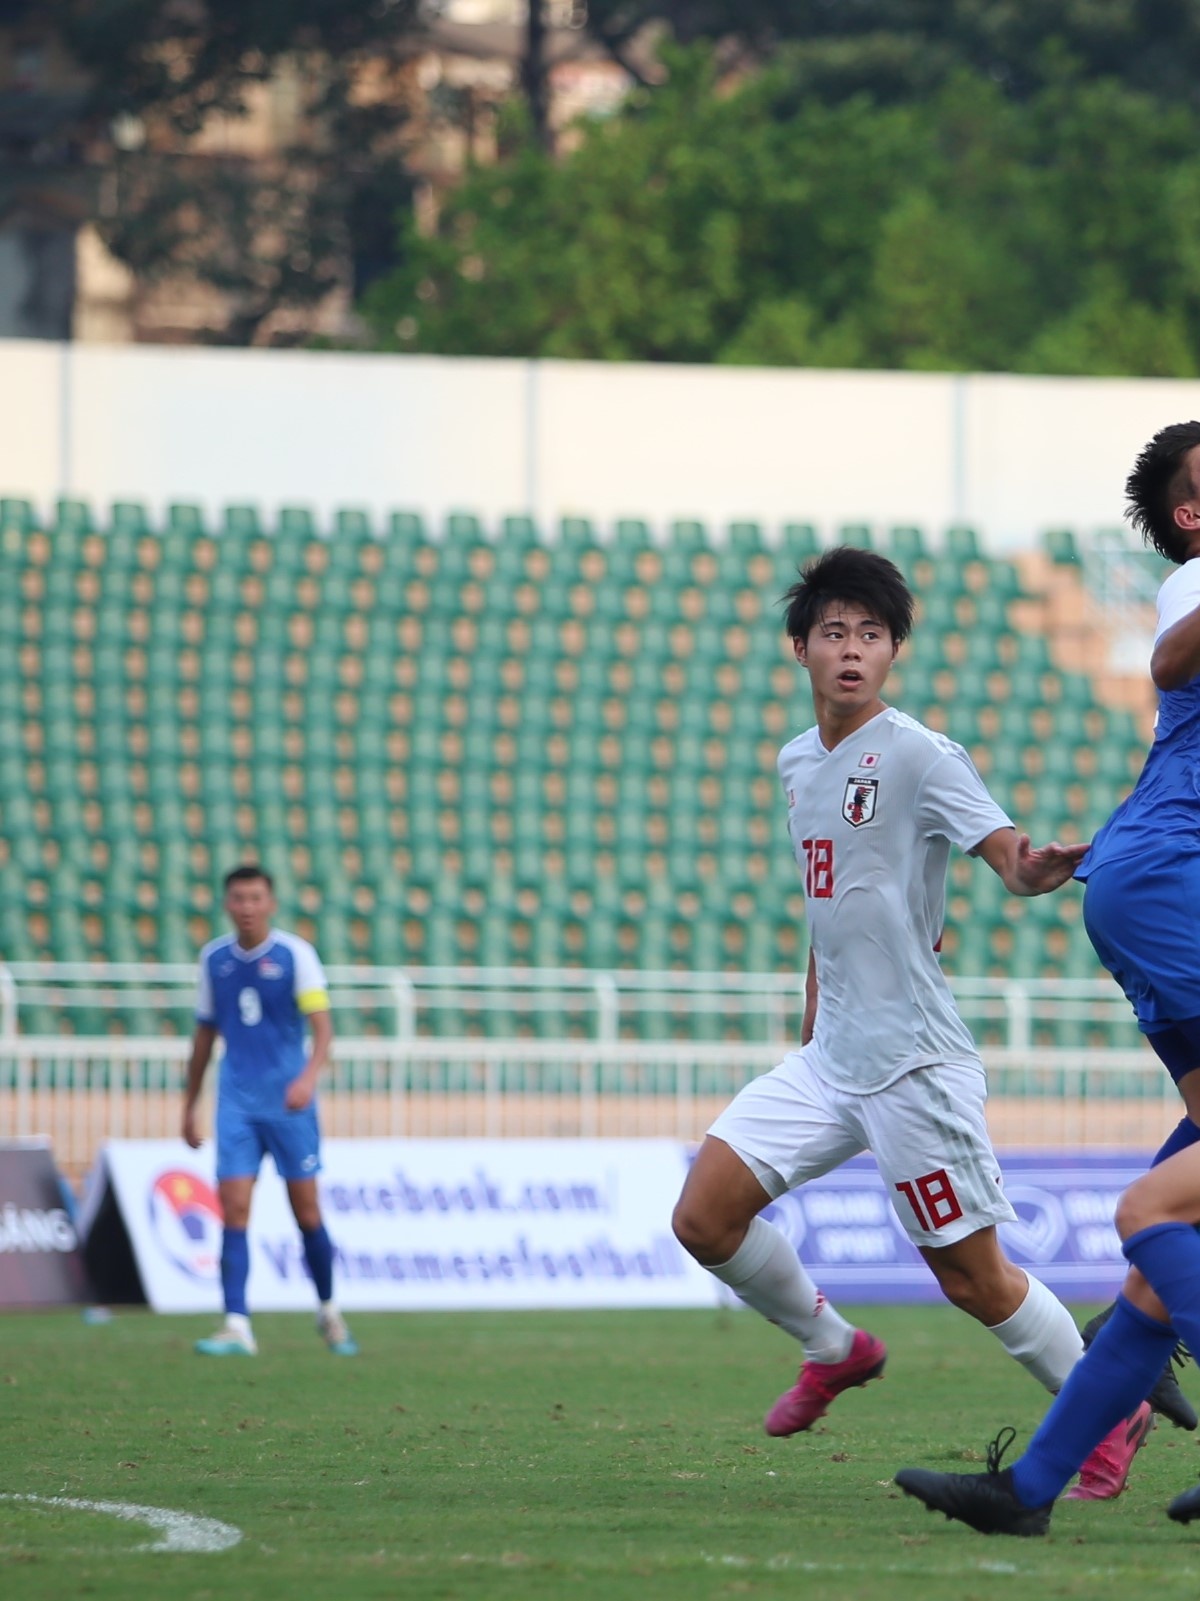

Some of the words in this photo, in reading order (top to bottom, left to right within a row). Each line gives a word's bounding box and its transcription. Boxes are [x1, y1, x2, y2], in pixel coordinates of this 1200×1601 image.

[802, 839, 833, 897] 18
[322, 1164, 618, 1211] acebook.com/
[895, 1168, 963, 1232] 18
[260, 1233, 686, 1279] Vtnamesefootball
